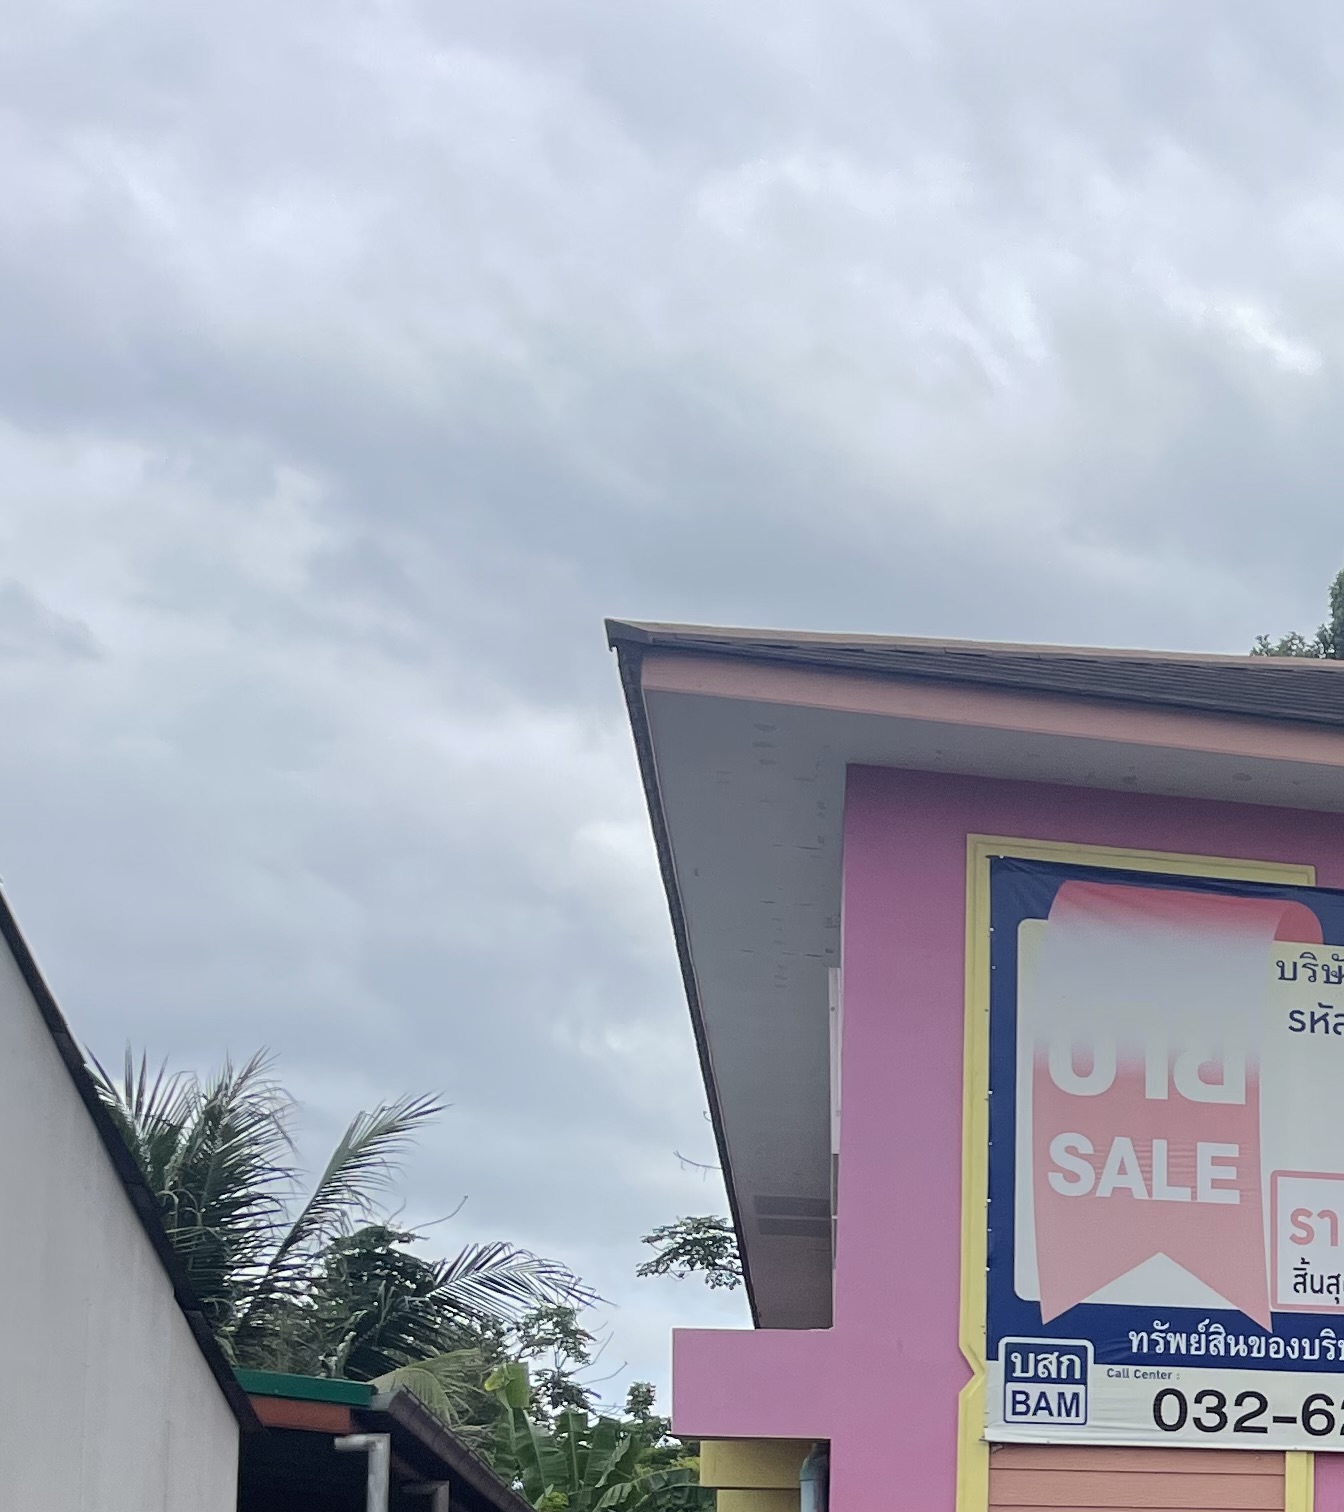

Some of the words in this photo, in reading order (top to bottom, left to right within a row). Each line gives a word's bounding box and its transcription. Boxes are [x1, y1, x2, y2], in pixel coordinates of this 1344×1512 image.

[1047, 1132, 1241, 1205] SALE
[1010, 1347, 1082, 1381] บสก
[1106, 1367, 1130, 1379] Call
[1133, 1368, 1173, 1380] Center
[1011, 1389, 1081, 1419] BAM
